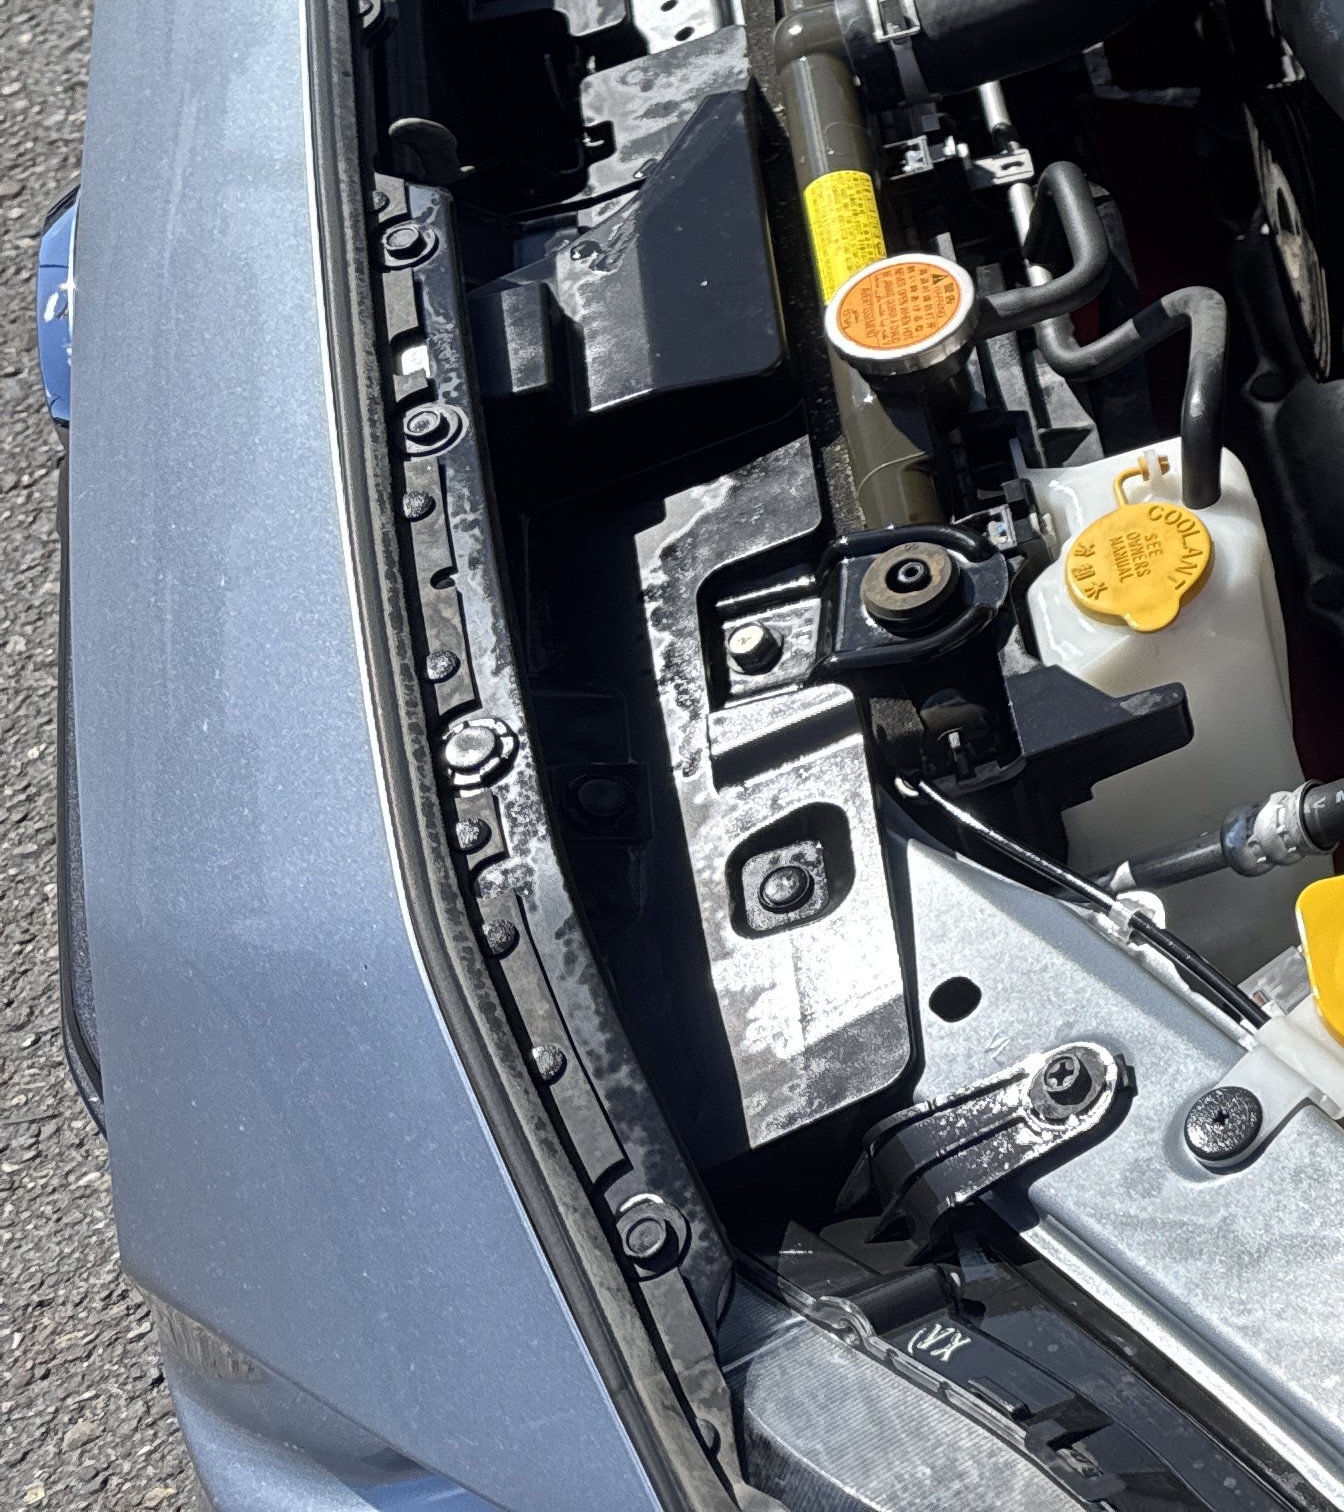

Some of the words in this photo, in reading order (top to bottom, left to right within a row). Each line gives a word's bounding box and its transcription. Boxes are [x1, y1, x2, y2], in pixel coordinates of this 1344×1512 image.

[1108, 536, 1133, 584] MANUAL
[1126, 532, 1152, 579] OWNERS
[1145, 532, 1164, 557] SEE
[1147, 503, 1205, 592] COOLANT
